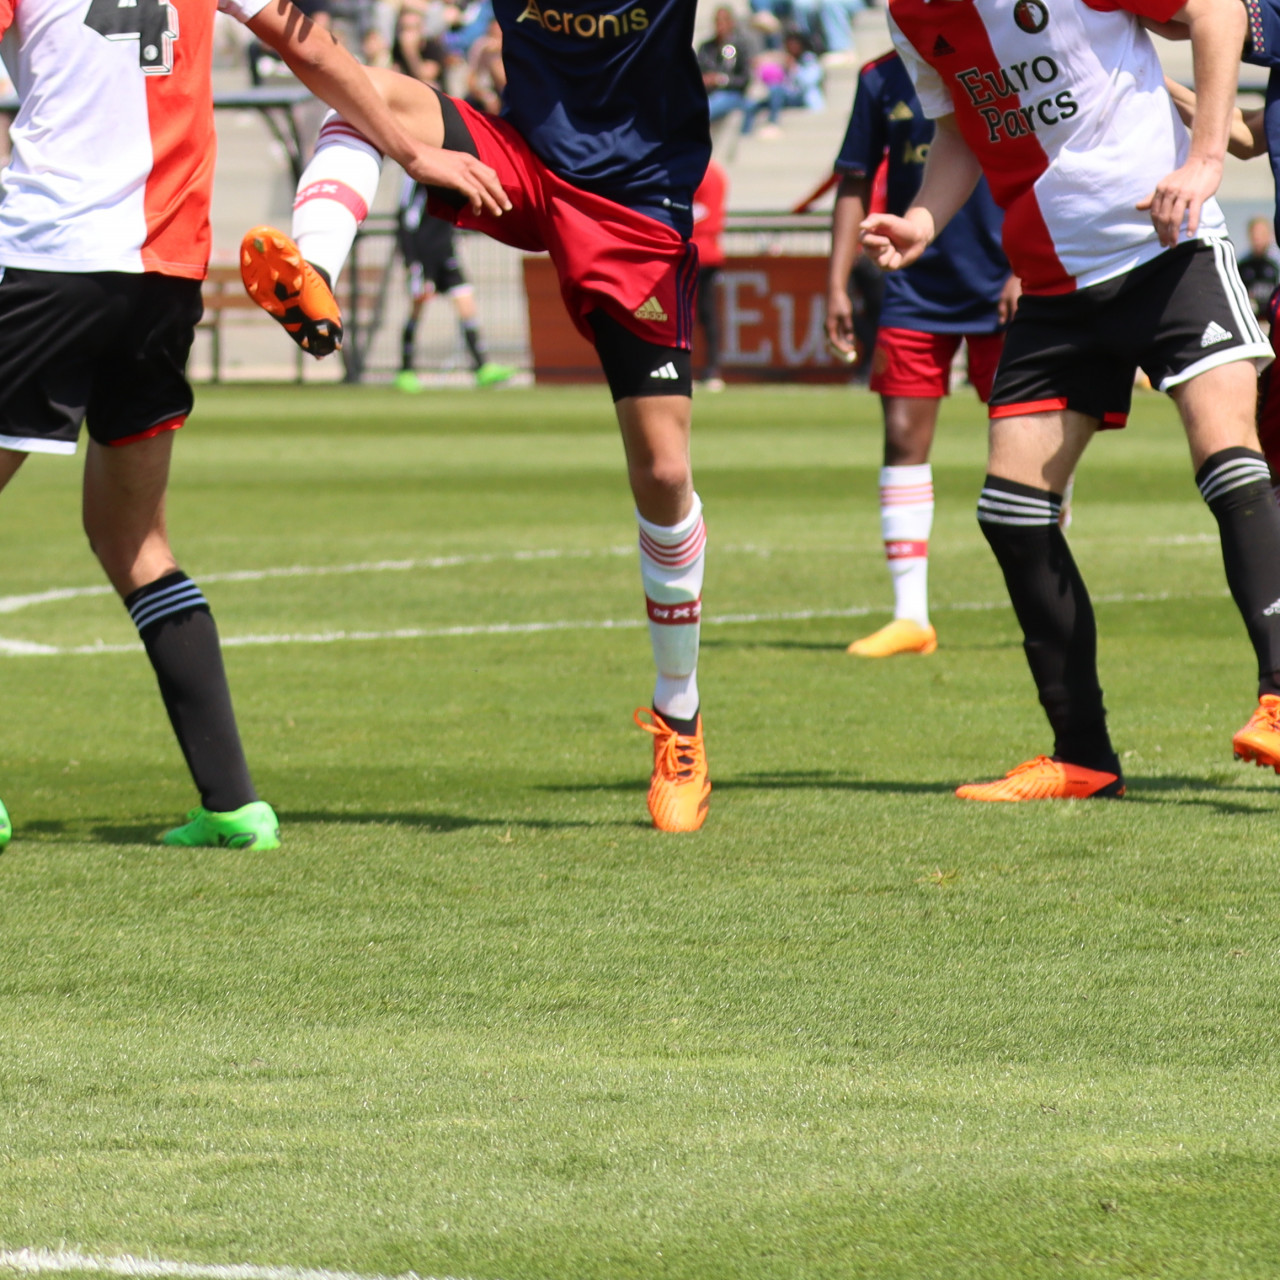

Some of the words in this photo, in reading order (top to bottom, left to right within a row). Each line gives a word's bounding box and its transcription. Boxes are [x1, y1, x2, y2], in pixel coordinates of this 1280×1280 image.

[955, 55, 1059, 107] Euro
[979, 90, 1079, 143] Parcs
[634, 311, 668, 322] adidas
